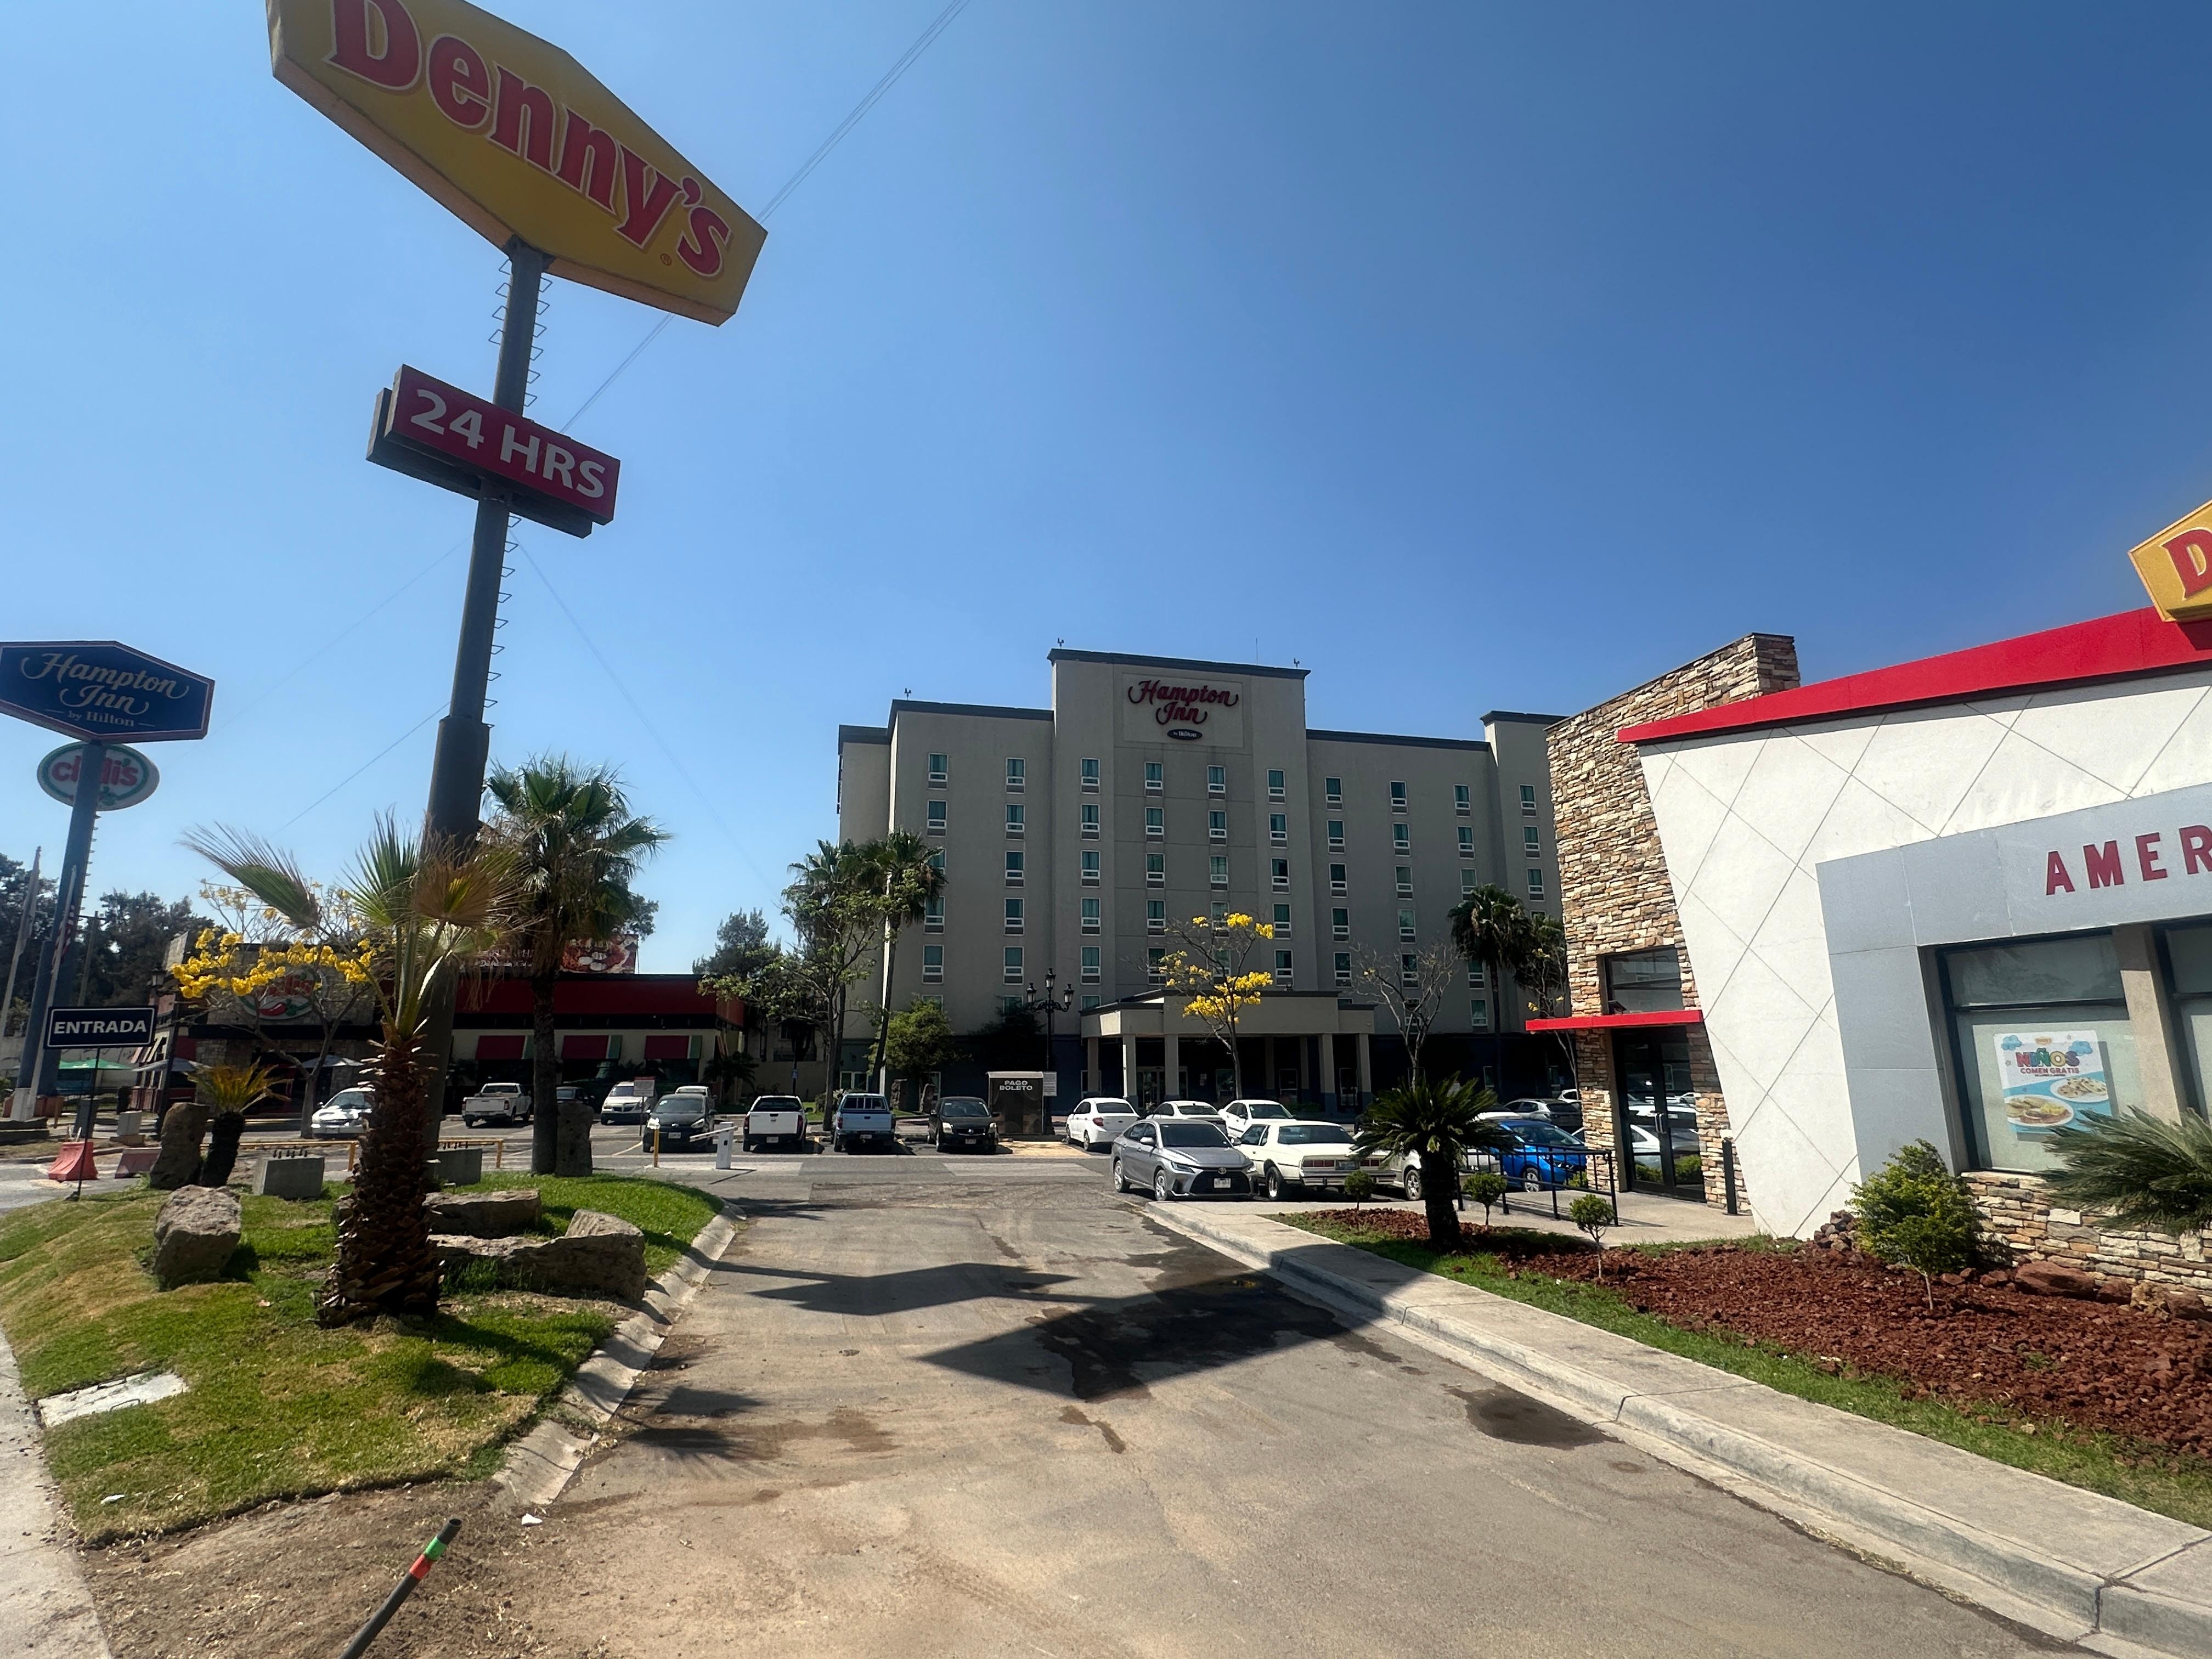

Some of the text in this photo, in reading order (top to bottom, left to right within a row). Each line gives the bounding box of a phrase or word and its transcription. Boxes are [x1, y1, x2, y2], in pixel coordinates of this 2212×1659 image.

[322, 0, 733, 277] Denny's
[410, 389, 606, 498] 24 HRS
[20, 653, 190, 699] Hampton
[59, 685, 149, 715] Inn
[1128, 679, 1239, 707] Hampton
[68, 710, 134, 726] by Hilton
[1155, 702, 1207, 725] Inn
[2046, 825, 2212, 895] AMER
[54, 1020, 146, 1034] ENTRADA
[2016, 1047, 2080, 1067] NIÑOS
